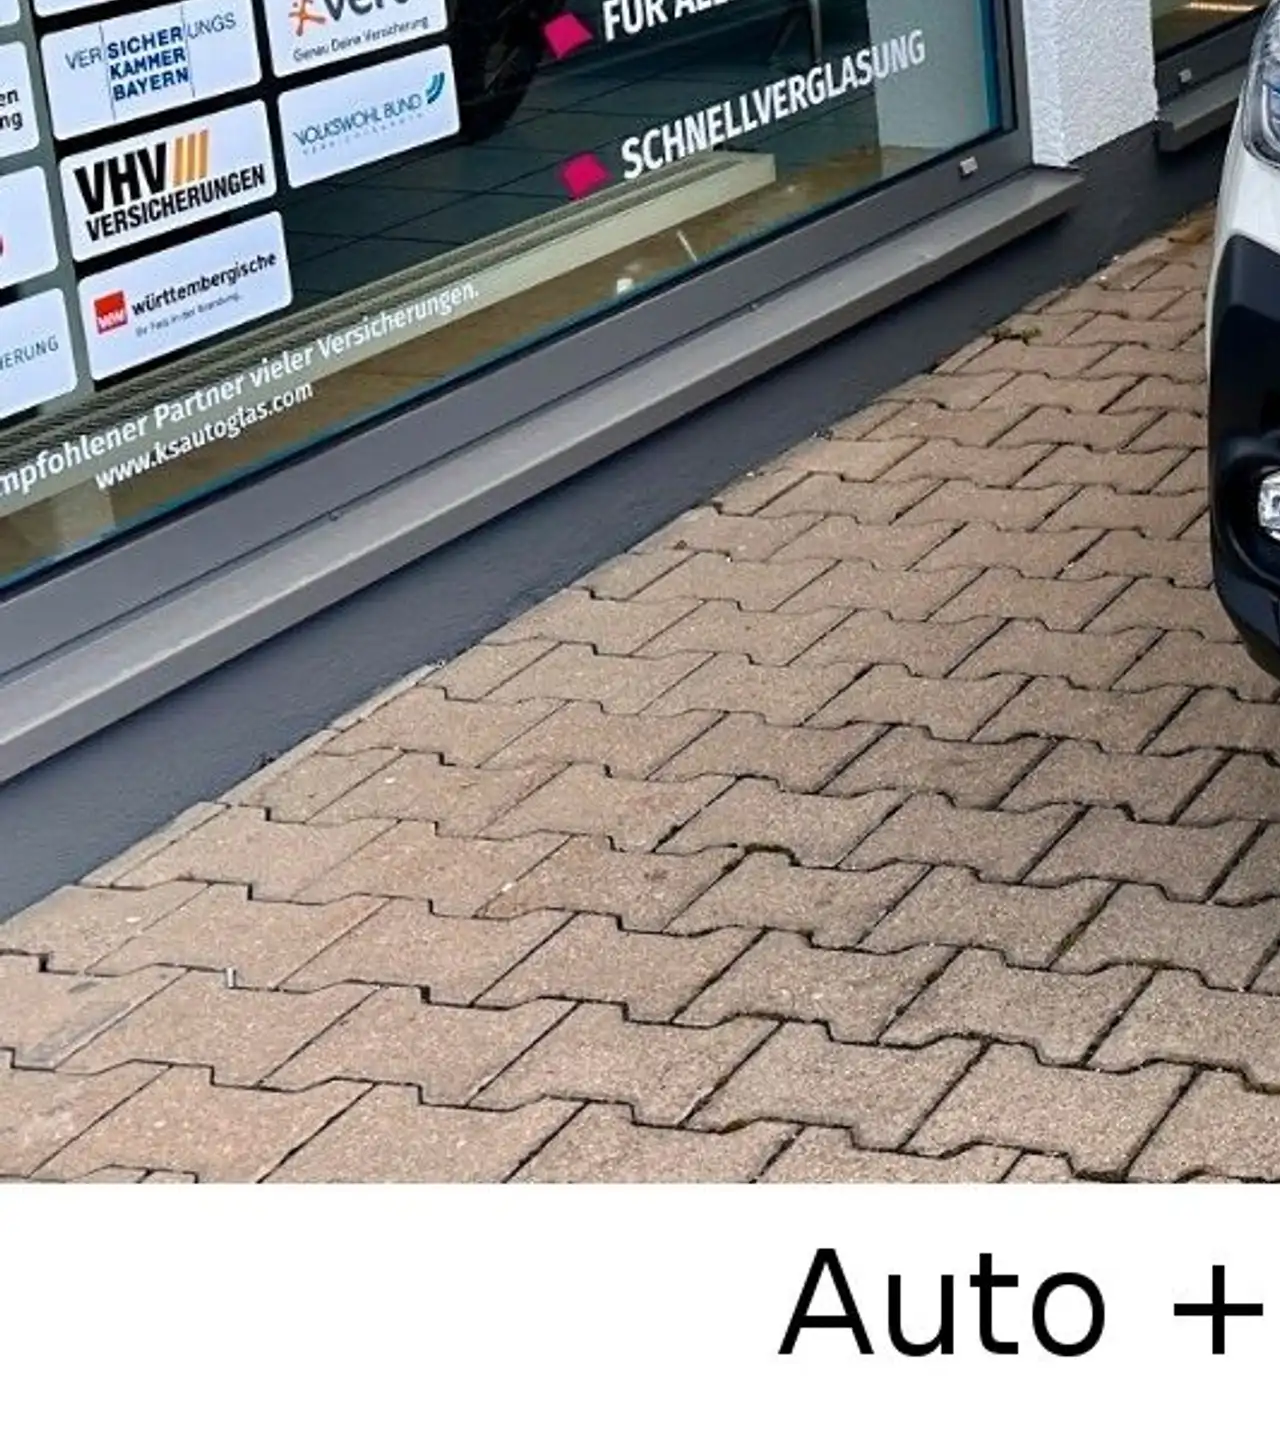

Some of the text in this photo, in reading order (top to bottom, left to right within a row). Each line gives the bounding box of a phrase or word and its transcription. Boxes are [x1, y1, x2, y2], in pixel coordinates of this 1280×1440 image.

[65, 13, 236, 70] VER SICHER UNGS
[109, 47, 186, 80] KAMMER
[113, 68, 189, 101] BAYERN
[621, 30, 926, 180] SCHNELLVERGLASUNG
[74, 142, 167, 215] VHV
[86, 163, 265, 242] VERSICHERUNGEN
[131, 252, 276, 316] württembergische
[154, 375, 243, 430] Partner
[250, 346, 313, 387] vieler
[317, 281, 480, 358] Versicherungen.
[95, 382, 314, 490] www.ksautoglas.com
